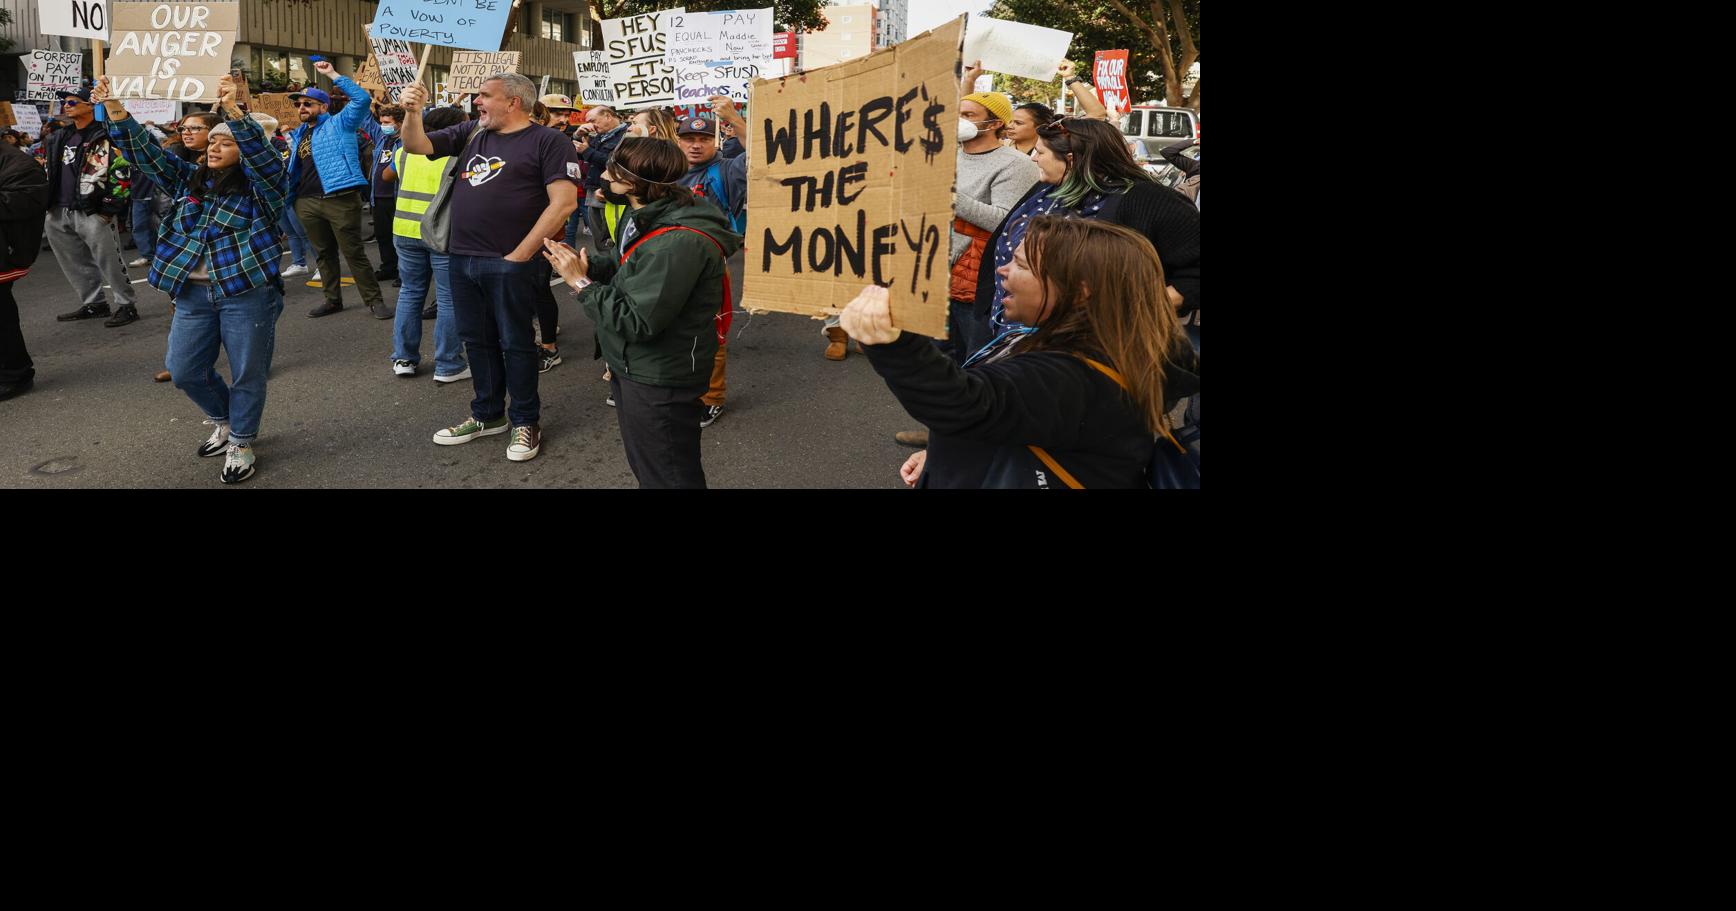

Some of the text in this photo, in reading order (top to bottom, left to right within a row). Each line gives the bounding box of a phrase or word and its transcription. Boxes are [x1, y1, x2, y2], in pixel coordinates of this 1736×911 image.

[475, 0, 497, 11] BE
[151, 4, 209, 30] OUR
[382, 6, 477, 27] A VOW OF
[670, 16, 684, 28] 12
[723, 13, 756, 25] PAY
[621, 13, 660, 36] HEY
[379, 23, 457, 44] POVERTY.
[675, 31, 712, 42] EQUAL
[719, 31, 757, 40] Maddie
[116, 31, 222, 58] ANGER
[725, 42, 744, 51] Now
[33, 50, 81, 64] CORRECT
[453, 52, 472, 63] IT
[482, 52, 517, 65] ILLEGAL
[590, 51, 602, 61] PAY
[45, 62, 71, 75] PAY
[151, 56, 181, 80] IS
[453, 64, 509, 76] NOT TO PAY
[675, 64, 759, 84] Keep SFUSD
[29, 72, 79, 85] ON TIME
[594, 79, 606, 88] NOT
[111, 75, 205, 100] VALID
[674, 84, 730, 100] Teachers
[731, 90, 742, 99] in
[764, 81, 945, 166] WHERE'$
[780, 161, 868, 212] THE
[762, 208, 940, 303] MONEY?
